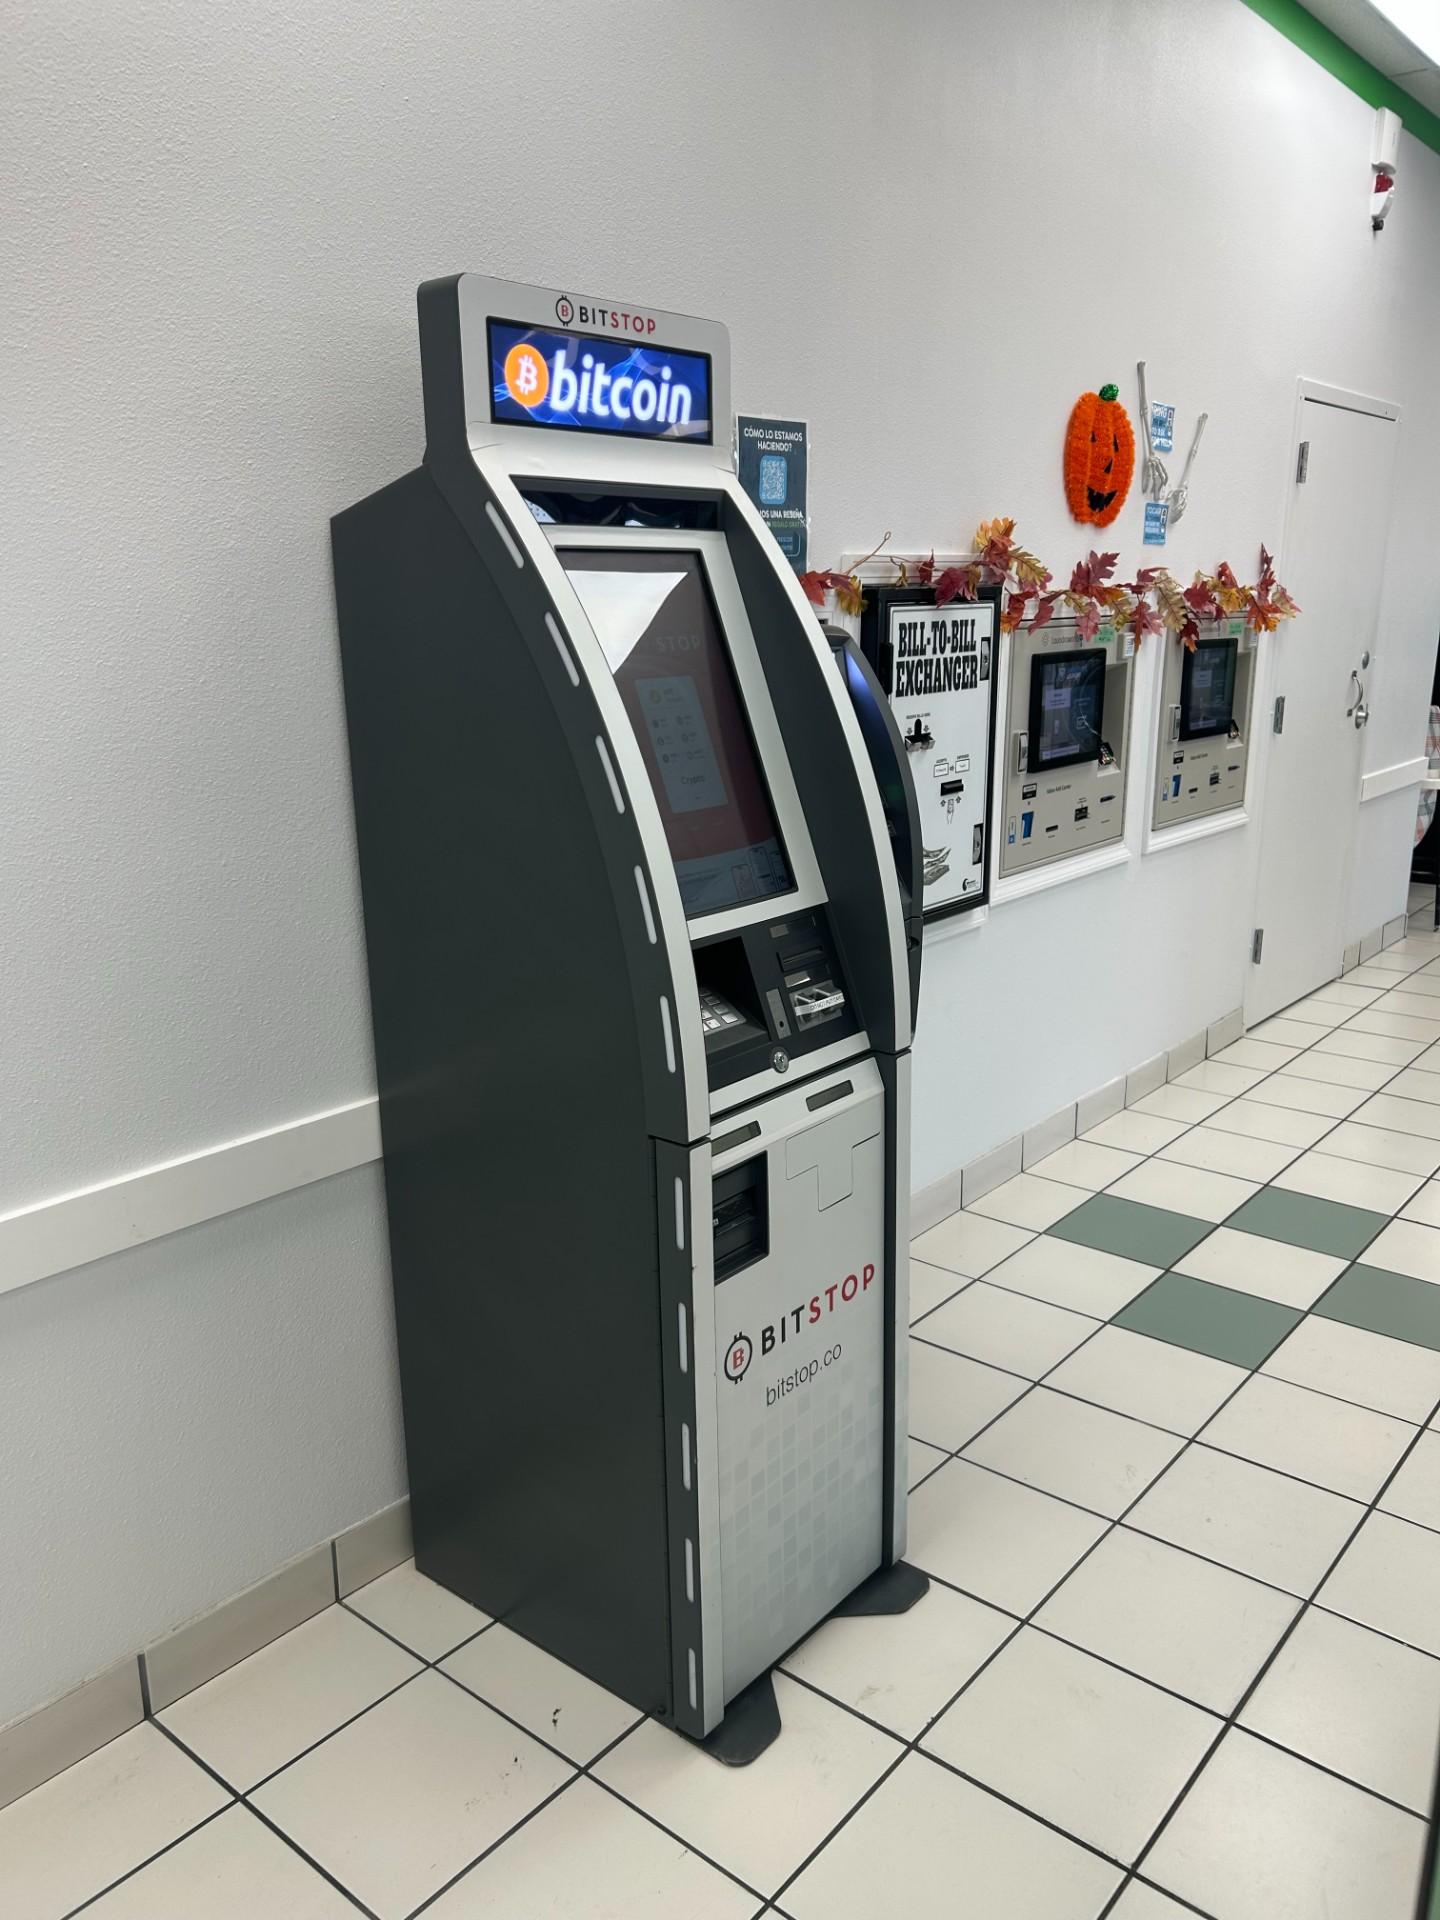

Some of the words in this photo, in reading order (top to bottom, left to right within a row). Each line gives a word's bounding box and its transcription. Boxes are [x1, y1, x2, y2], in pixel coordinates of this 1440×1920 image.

[579, 305, 656, 335] BITSTOP
[549, 349, 692, 425] bitcoin
[744, 426, 764, 438] CÓMO
[765, 430, 774, 439] LO
[775, 430, 802, 442] ESTAMOS
[757, 440, 792, 452] HACIENDO?
[897, 618, 977, 658] BILL-TO-BILL
[895, 654, 978, 698] EXCHANGER
[761, 1263, 875, 1356] BITSTOP
[766, 1343, 842, 1408] bitstop.co
